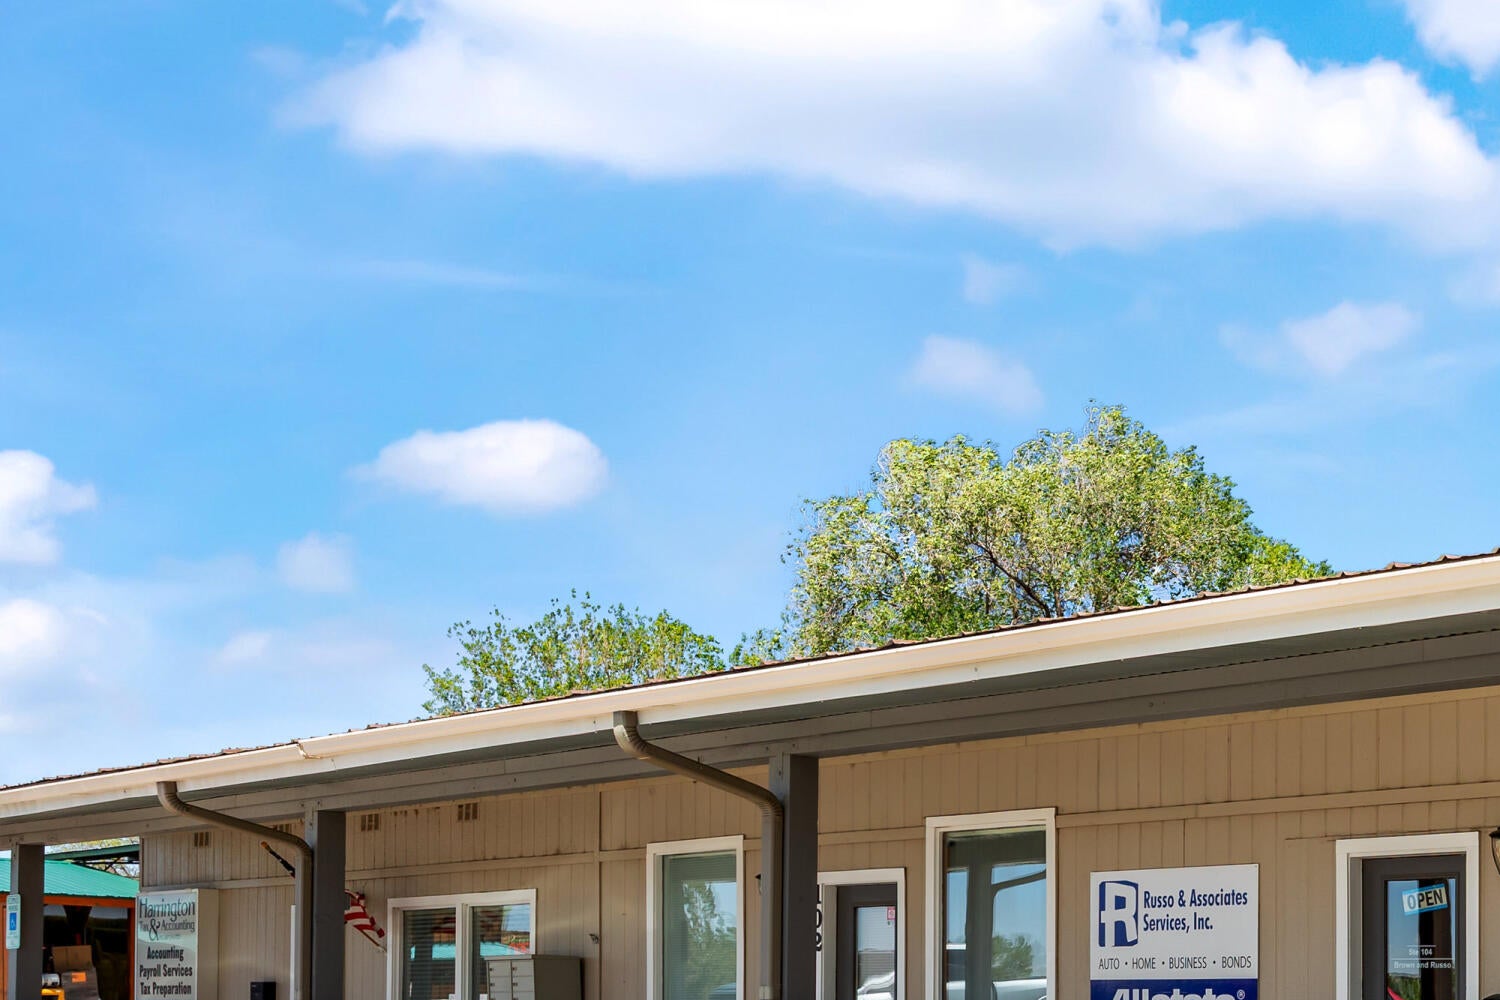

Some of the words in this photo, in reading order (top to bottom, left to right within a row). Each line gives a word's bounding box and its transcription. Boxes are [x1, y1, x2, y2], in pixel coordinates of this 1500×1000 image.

[1143, 890, 1174, 909] Russo
[1178, 889, 1187, 908] &
[1189, 888, 1248, 907] Associates
[1407, 888, 1444, 910] OPEN
[139, 897, 196, 923] Harrington
[139, 920, 150, 932] Tax
[148, 918, 160, 941] &
[161, 919, 196, 933] Accounting
[1143, 913, 1190, 934] Services,
[1193, 911, 1214, 931] Inc.
[146, 945, 185, 961] Accounting
[1421, 948, 1433, 956] 104
[139, 963, 162, 980] Payroll
[162, 962, 193, 977] Services
[1098, 957, 1120, 970] AUTO
[1131, 957, 1156, 970] HOME
[1168, 956, 1208, 969] BUSINESS
[1221, 955, 1252, 969] BONDS
[1416, 961, 1429, 969] and
[140, 981, 151, 995] Tax
[152, 981, 192, 998] Preparation
